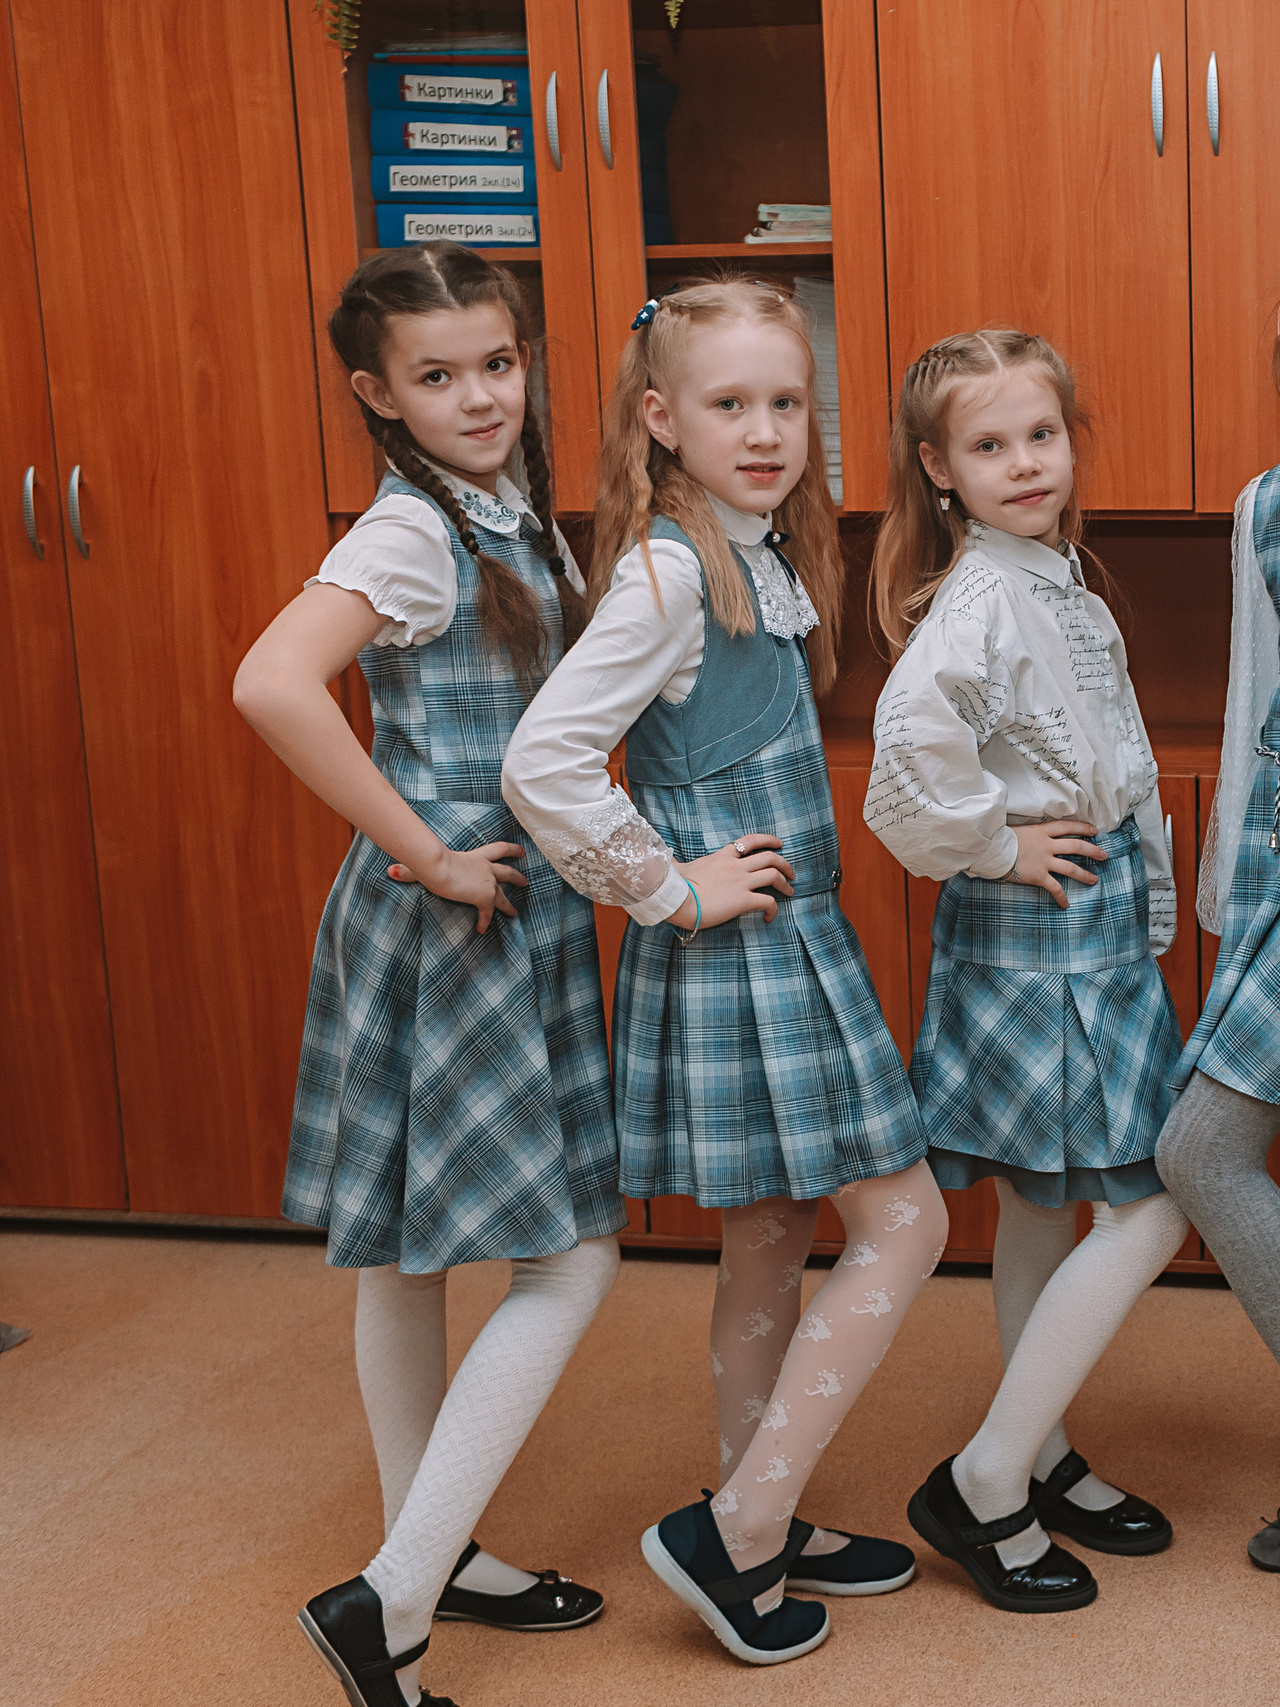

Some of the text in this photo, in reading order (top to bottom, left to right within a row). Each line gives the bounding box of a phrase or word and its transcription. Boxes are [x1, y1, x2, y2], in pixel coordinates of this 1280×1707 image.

[417, 82, 494, 100] Картинки
[419, 129, 498, 147] Картинки
[392, 171, 477, 189] Геометрия
[408, 220, 493, 238] Геометрия
